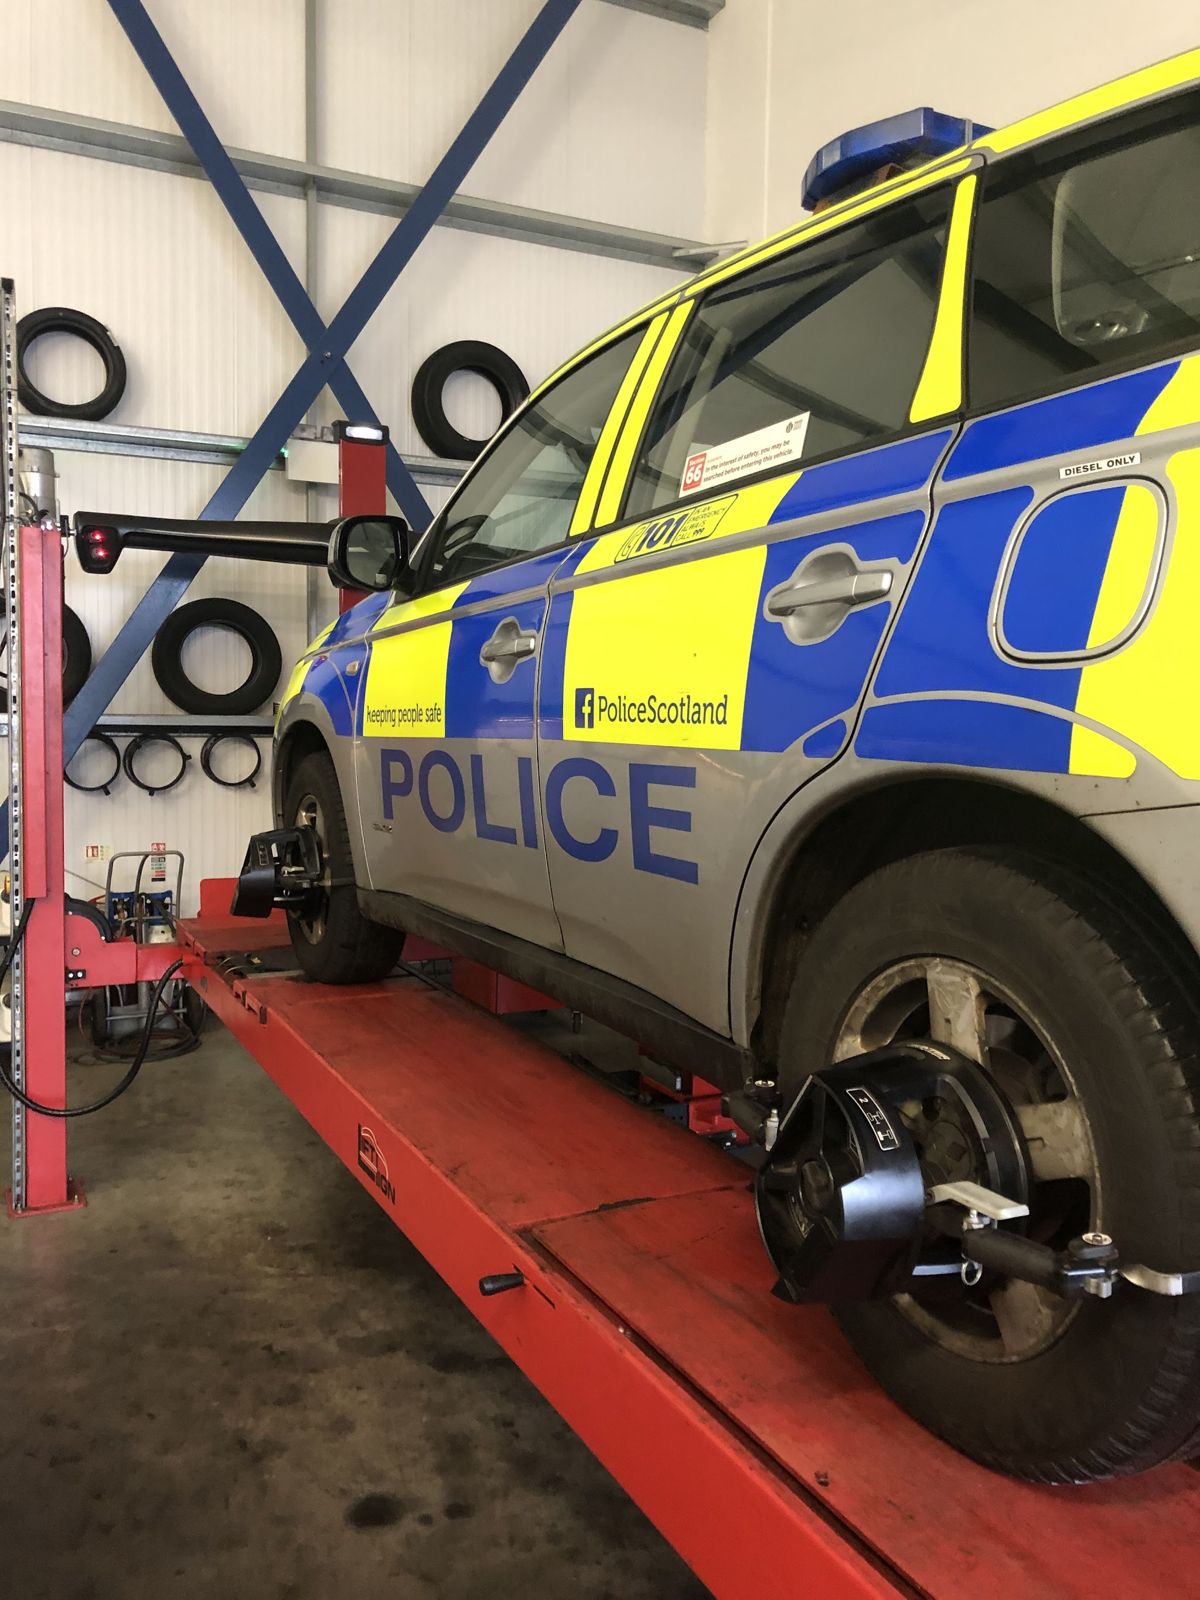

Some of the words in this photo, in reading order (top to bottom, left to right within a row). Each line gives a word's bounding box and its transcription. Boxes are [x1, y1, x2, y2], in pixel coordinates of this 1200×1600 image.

[711, 462, 719, 471] the
[719, 457, 737, 468] interest
[761, 446, 771, 456] you
[771, 442, 783, 453] may
[725, 465, 741, 475] before
[741, 459, 763, 471] entering
[763, 454, 773, 463] this
[1064, 462, 1103, 476] DIESEL
[1106, 455, 1136, 468] ONLY
[685, 463, 703, 485] 66
[689, 507, 727, 522] EMERGENCY
[635, 512, 690, 553] 101
[692, 527, 706, 536] 999
[366, 704, 397, 728] keeping
[397, 703, 423, 728] people
[425, 702, 442, 723] safe
[597, 694, 729, 725] PoliceScotland
[380, 748, 699, 886] POLICE
